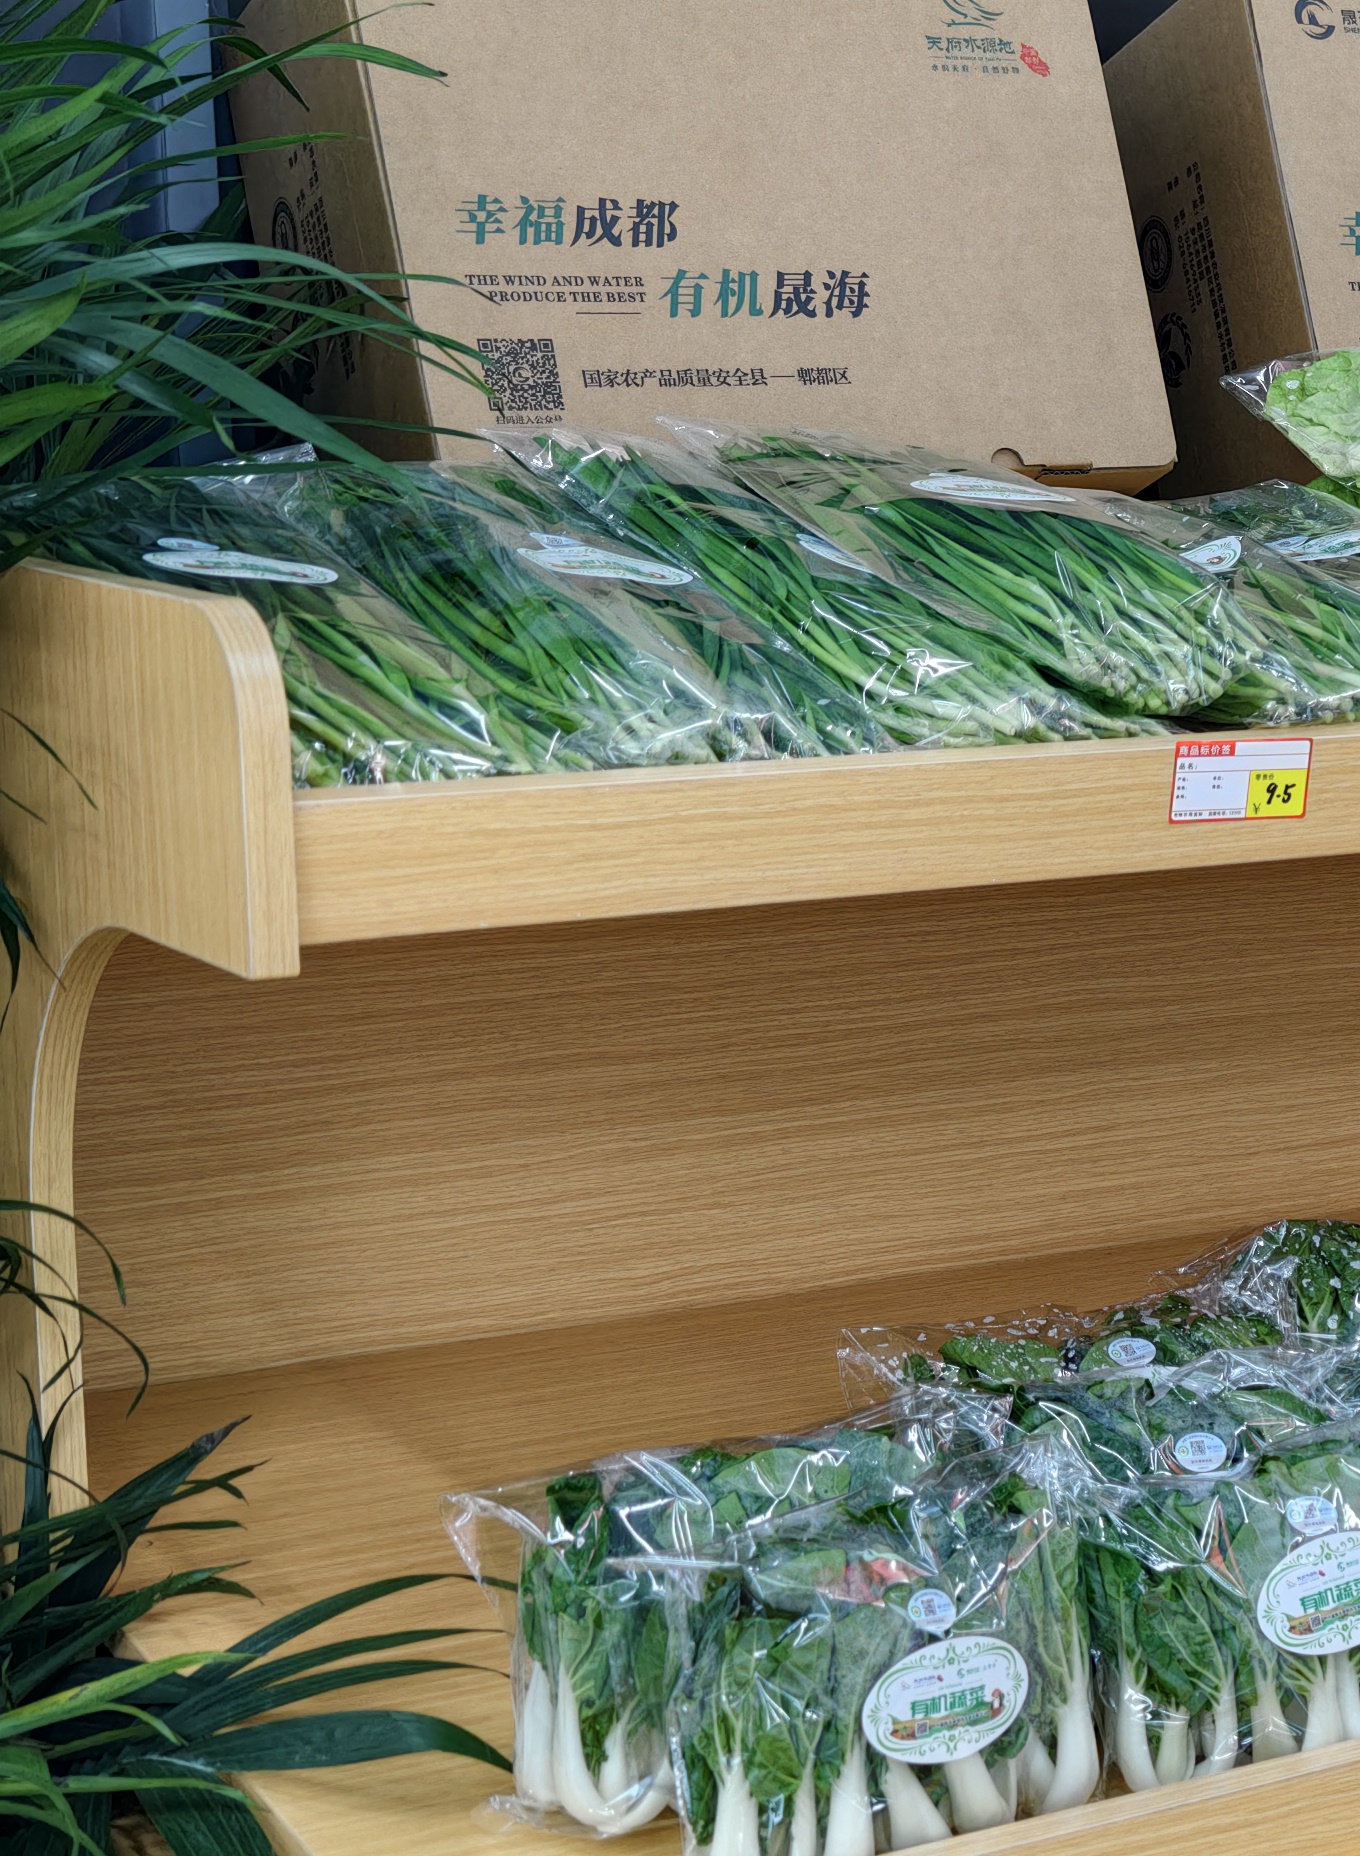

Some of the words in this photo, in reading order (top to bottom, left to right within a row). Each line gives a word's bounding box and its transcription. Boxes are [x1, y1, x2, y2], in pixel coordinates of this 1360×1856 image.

[925, 35, 1015, 54] 天府水源地
[455, 194, 680, 248] 幸福成都
[465, 274, 499, 286] THE
[503, 275, 547, 287] WIND
[551, 276, 585, 287] AND
[588, 275, 645, 287] WATER
[488, 290, 567, 303] PRODUCE
[569, 291, 604, 303] THE
[606, 291, 647, 304] BEST
[658, 268, 871, 319] 有机晟海
[1179, 745, 1231, 756] 商品标价签
[1266, 782, 1296, 805] 9.5
[911, 1684, 986, 1718] 有机蔬菜
